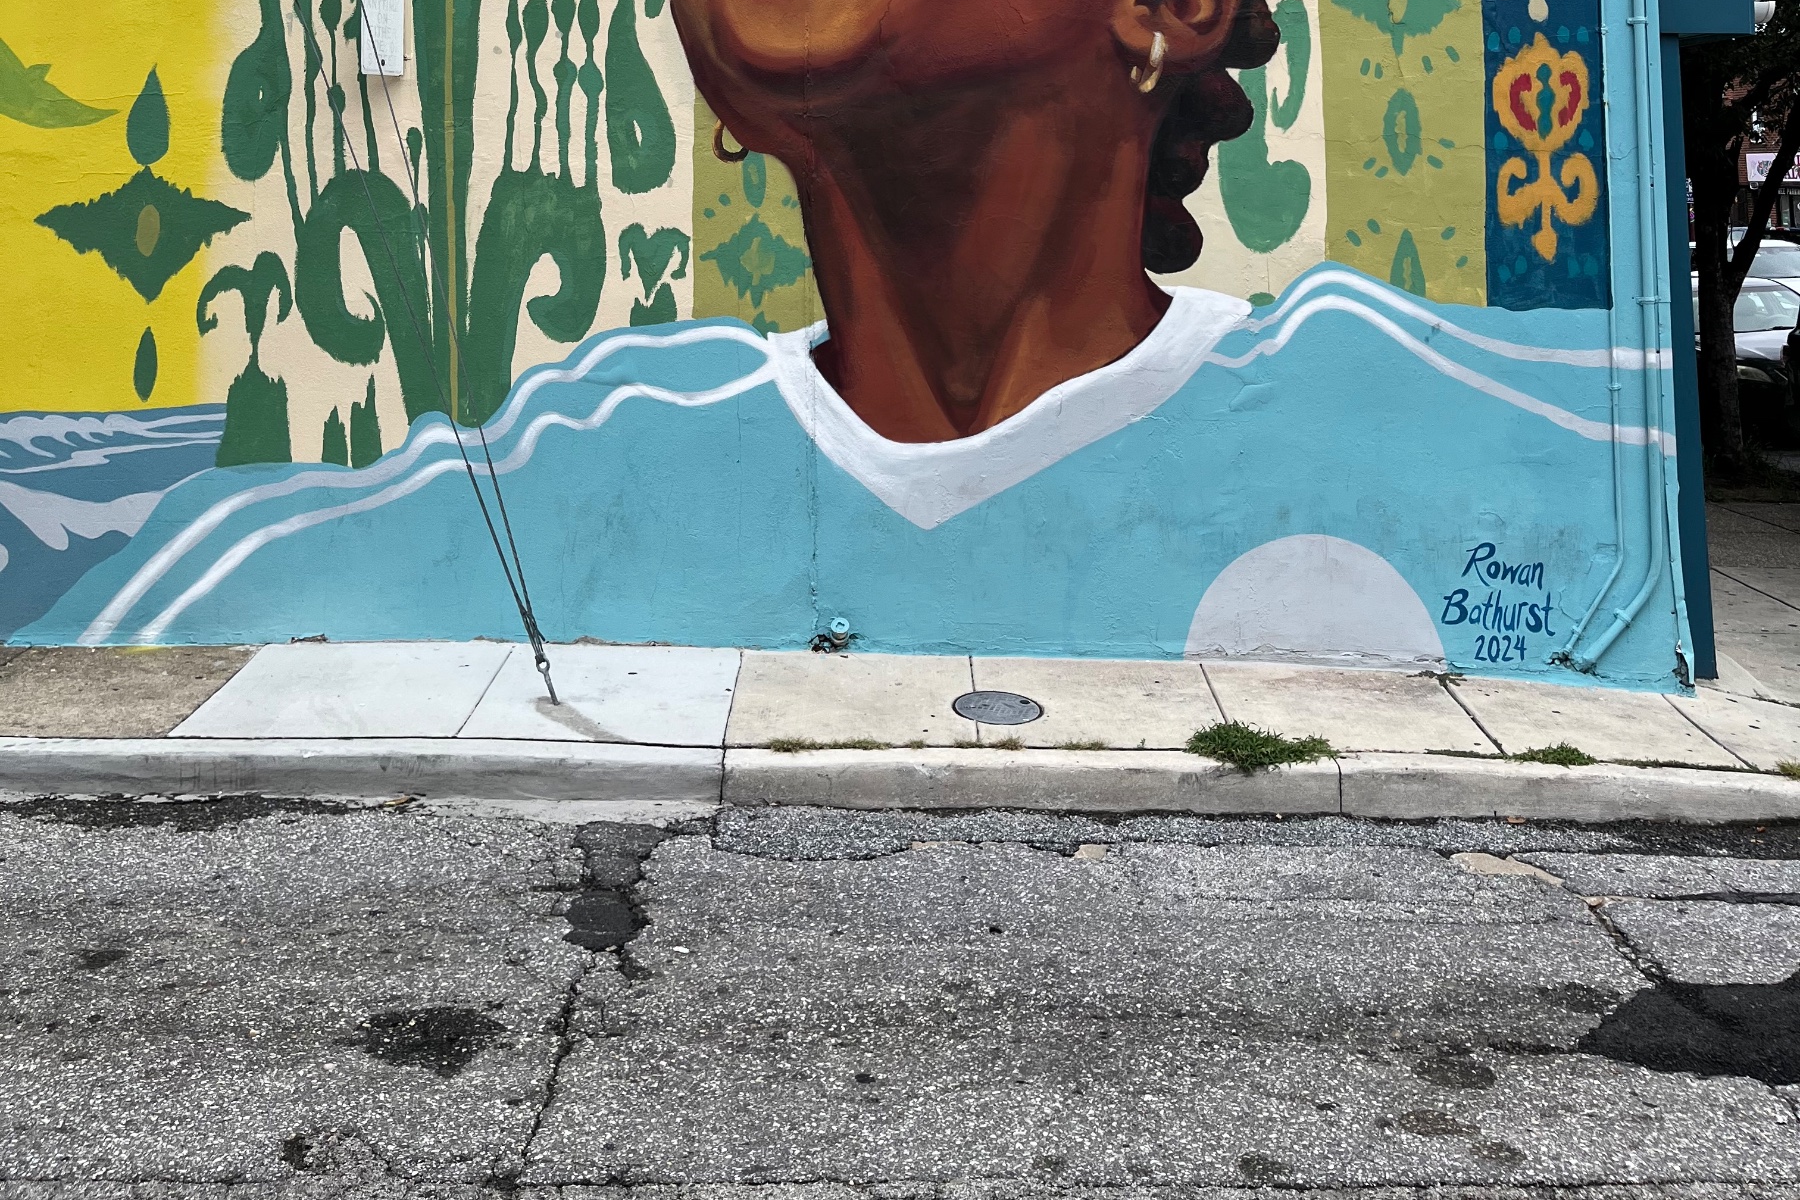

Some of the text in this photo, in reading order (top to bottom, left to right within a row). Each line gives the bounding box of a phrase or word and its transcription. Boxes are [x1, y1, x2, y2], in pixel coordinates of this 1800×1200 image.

[1461, 542, 1544, 591] Rowan
[1441, 588, 1556, 637] Bathurst
[1474, 634, 1527, 663] 2024
